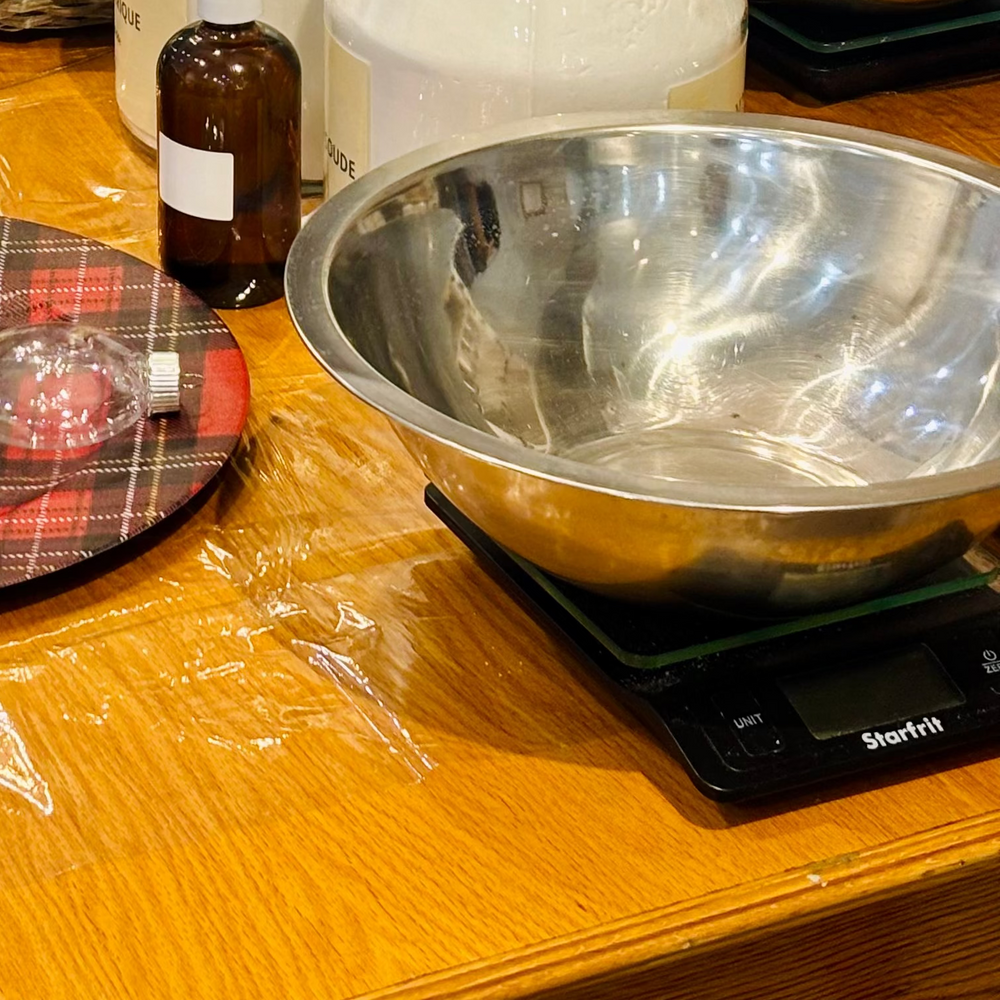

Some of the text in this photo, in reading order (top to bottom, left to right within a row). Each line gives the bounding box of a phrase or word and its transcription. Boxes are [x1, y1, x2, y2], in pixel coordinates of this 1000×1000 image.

[325, 131, 355, 180] OUDE
[733, 712, 764, 730] UNIT
[860, 716, 945, 750] Starfrit
